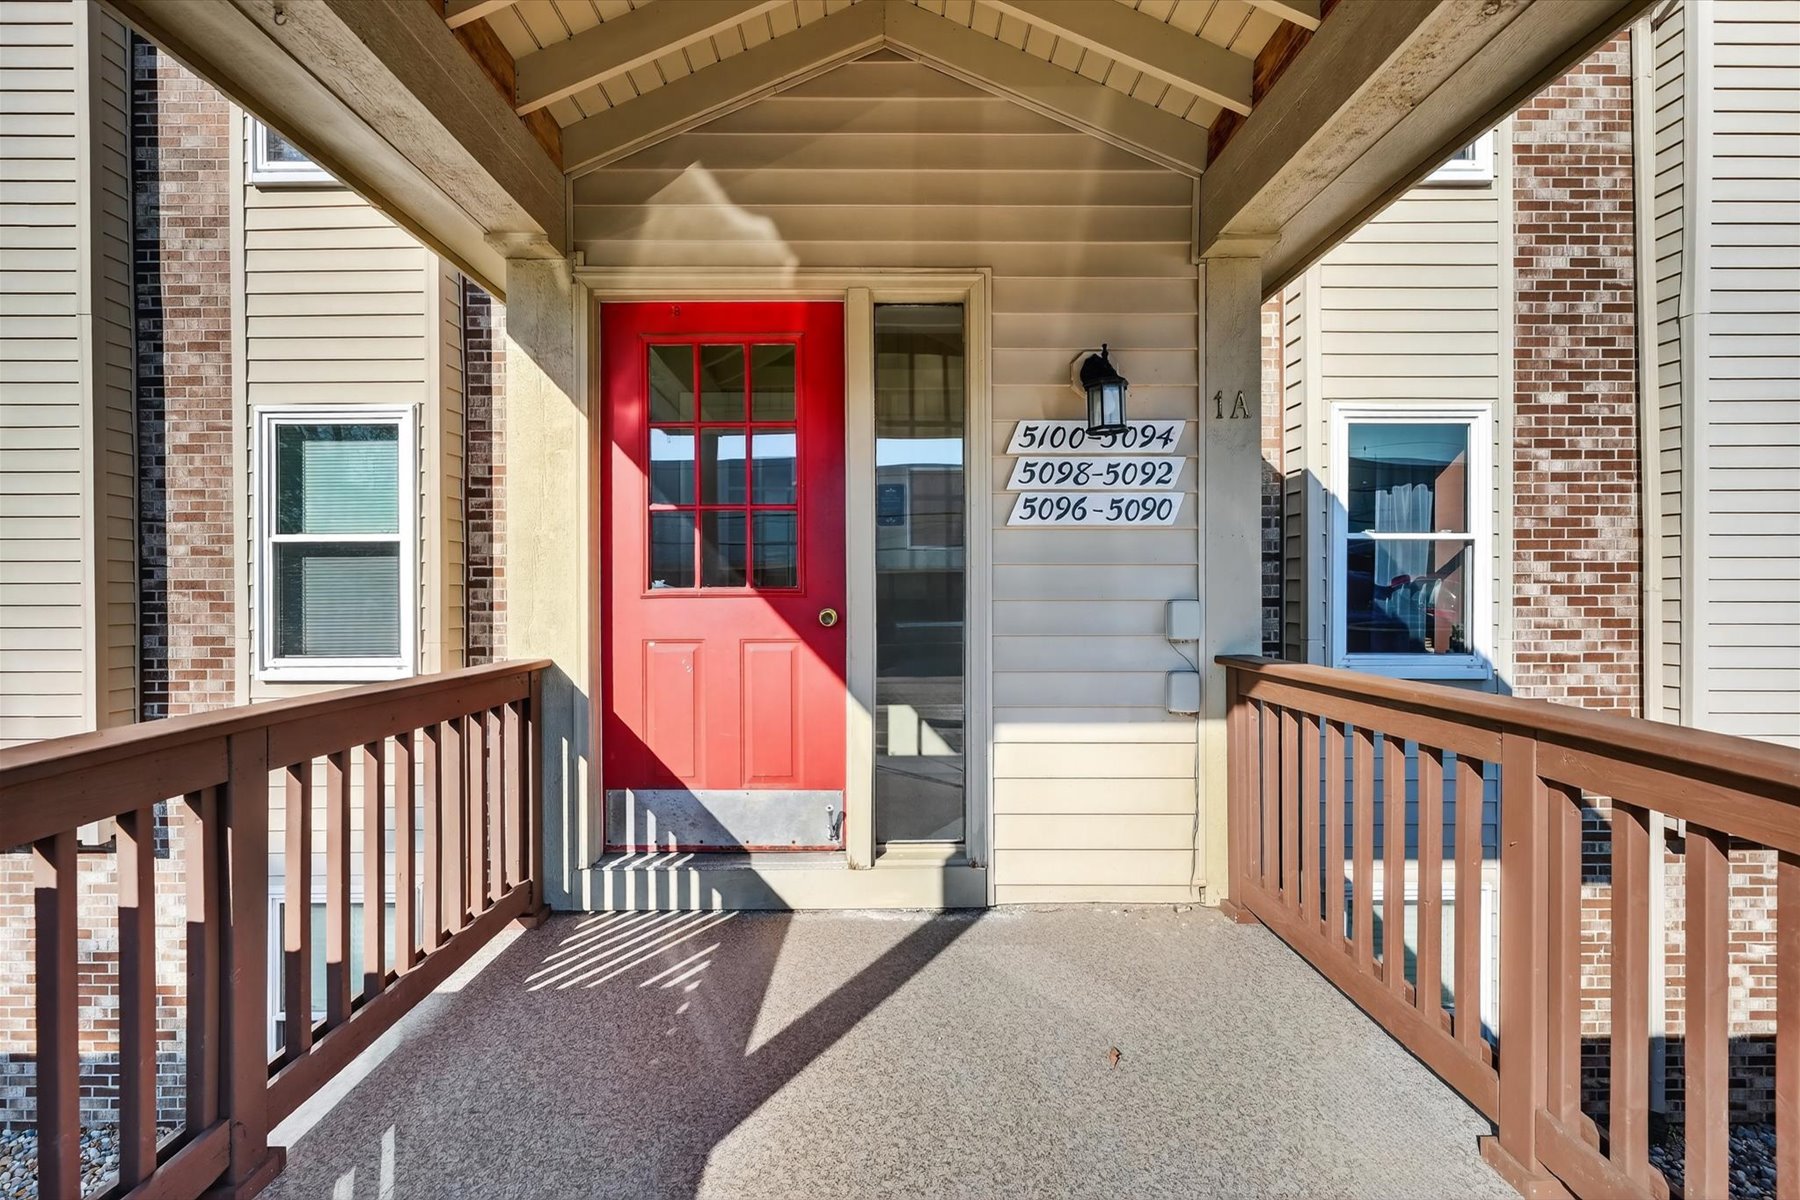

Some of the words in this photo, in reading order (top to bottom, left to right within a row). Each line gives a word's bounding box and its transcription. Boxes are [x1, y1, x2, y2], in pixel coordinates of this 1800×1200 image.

[1213, 390, 1252, 419] 1A
[1018, 461, 1175, 486] 5098-5092
[1018, 496, 1173, 521] 5096-5090
